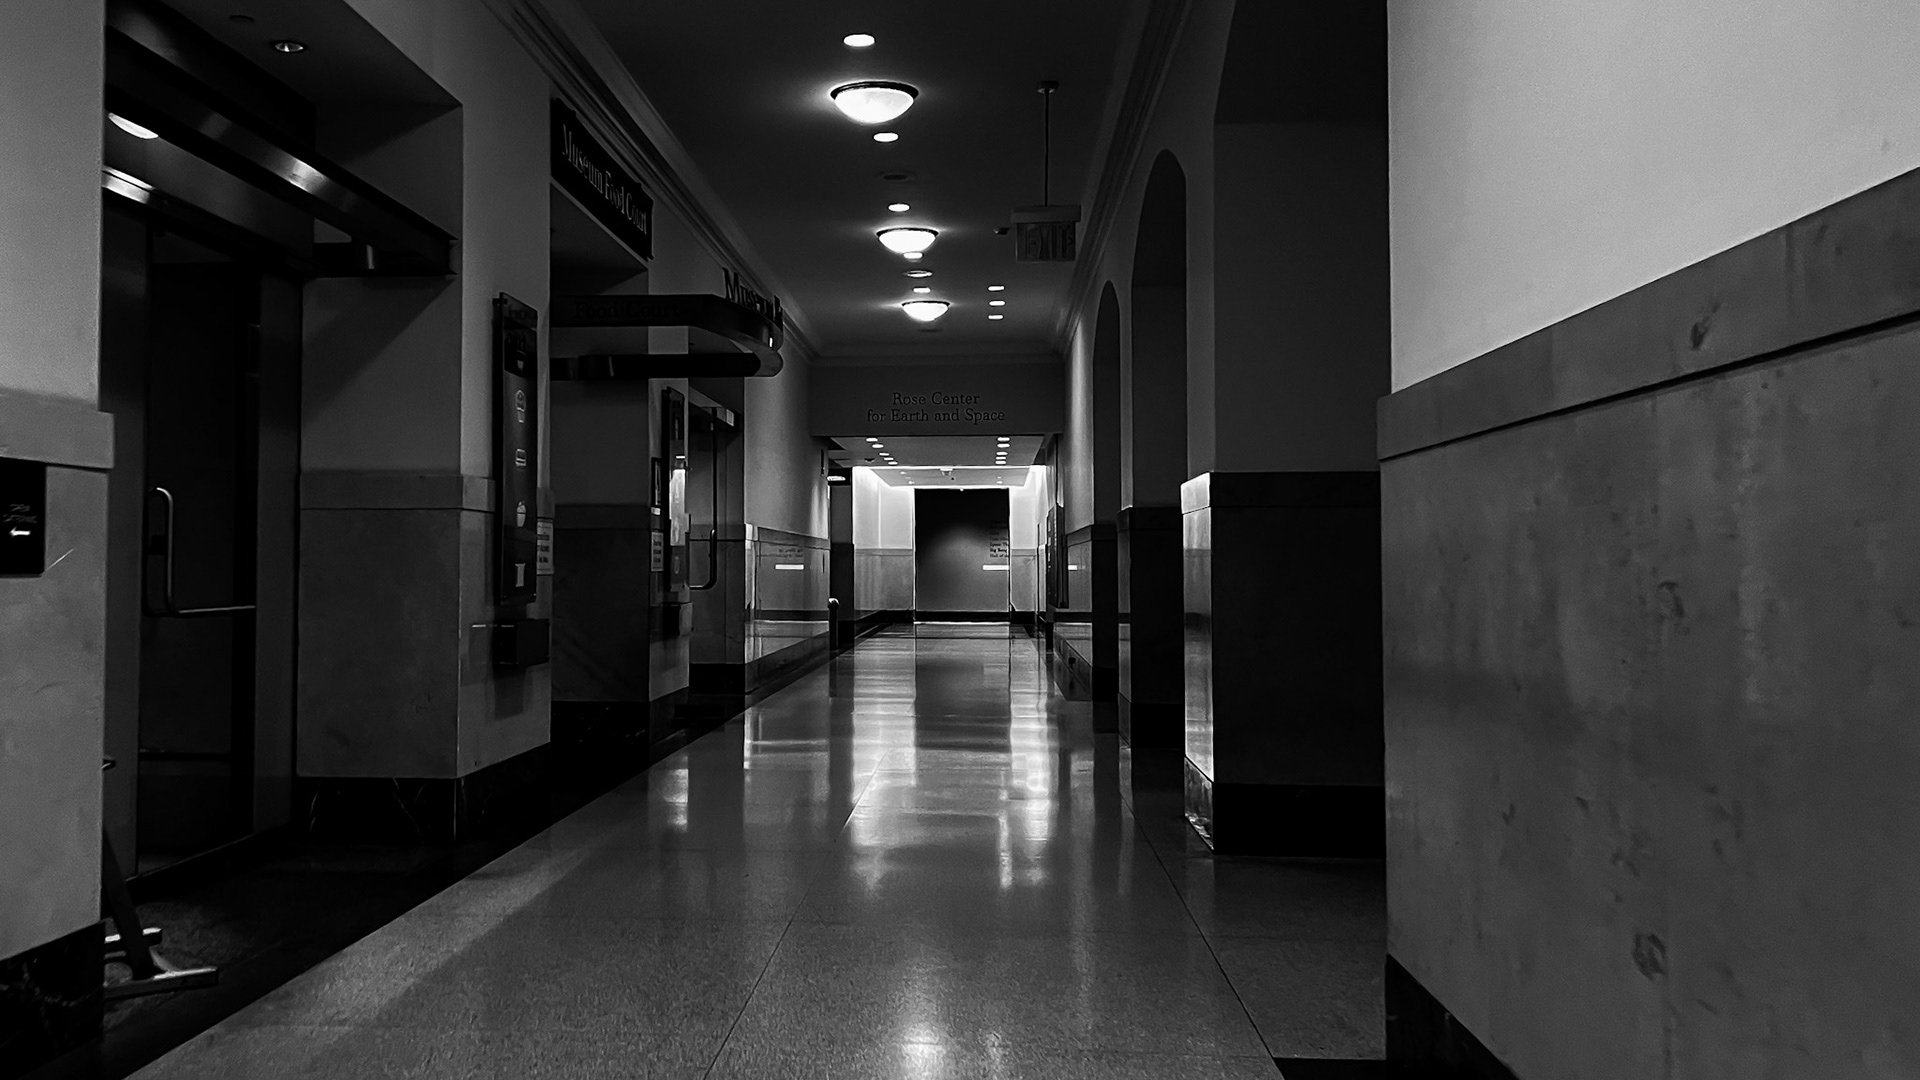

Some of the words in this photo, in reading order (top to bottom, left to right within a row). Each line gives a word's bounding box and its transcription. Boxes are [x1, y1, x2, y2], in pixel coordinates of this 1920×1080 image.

[561, 123, 604, 195] Museum
[604, 169, 626, 215] Food
[625, 192, 648, 235] Court
[1025, 225, 1071, 260] EXIT
[722, 267, 774, 318] Museum
[575, 301, 617, 318] Food
[626, 301, 680, 318] Court
[892, 392, 927, 406] Rose
[931, 391, 980, 405] Center
[867, 409, 886, 422] for
[890, 408, 929, 422] Earth
[934, 408, 960, 422] and
[964, 407, 1006, 426] Space
